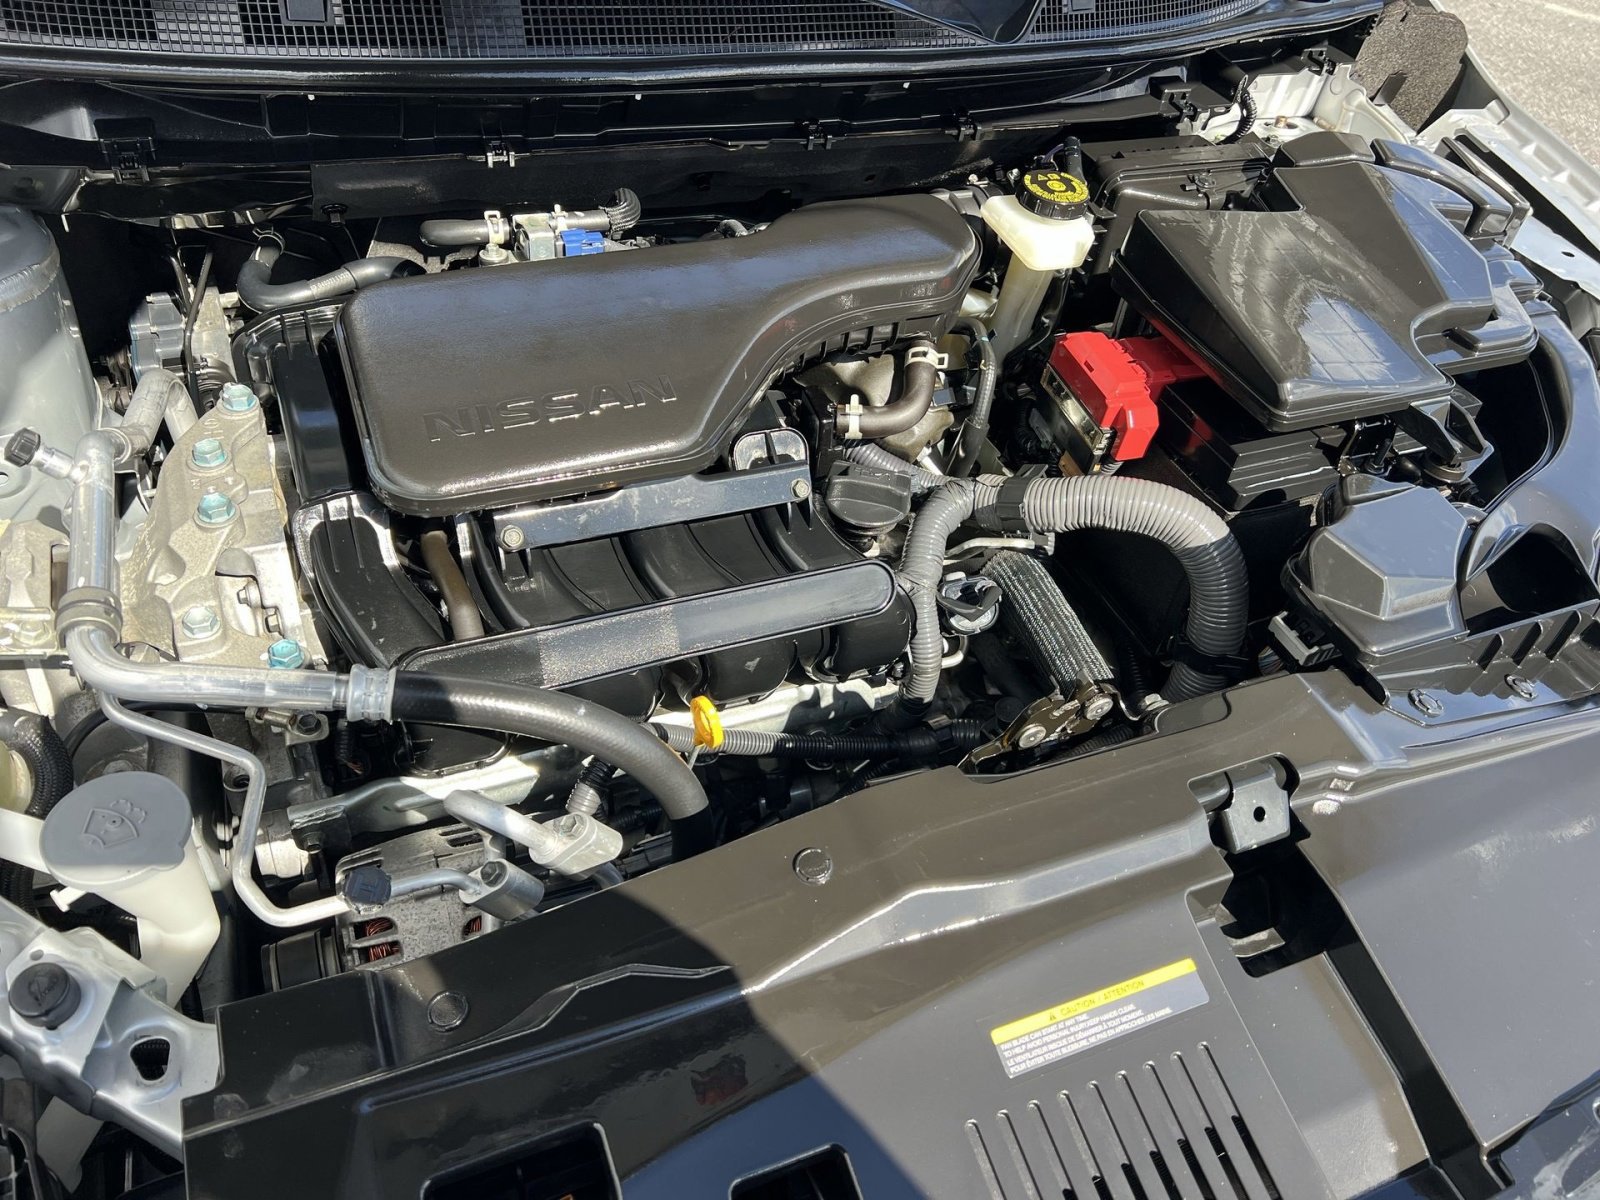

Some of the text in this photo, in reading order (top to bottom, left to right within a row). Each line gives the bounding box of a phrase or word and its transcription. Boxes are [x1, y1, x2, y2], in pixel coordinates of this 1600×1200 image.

[423, 375, 678, 442] NISSAN
[1060, 998, 1096, 1016] CAUTION
[1103, 980, 1145, 1001] ATTENTION
